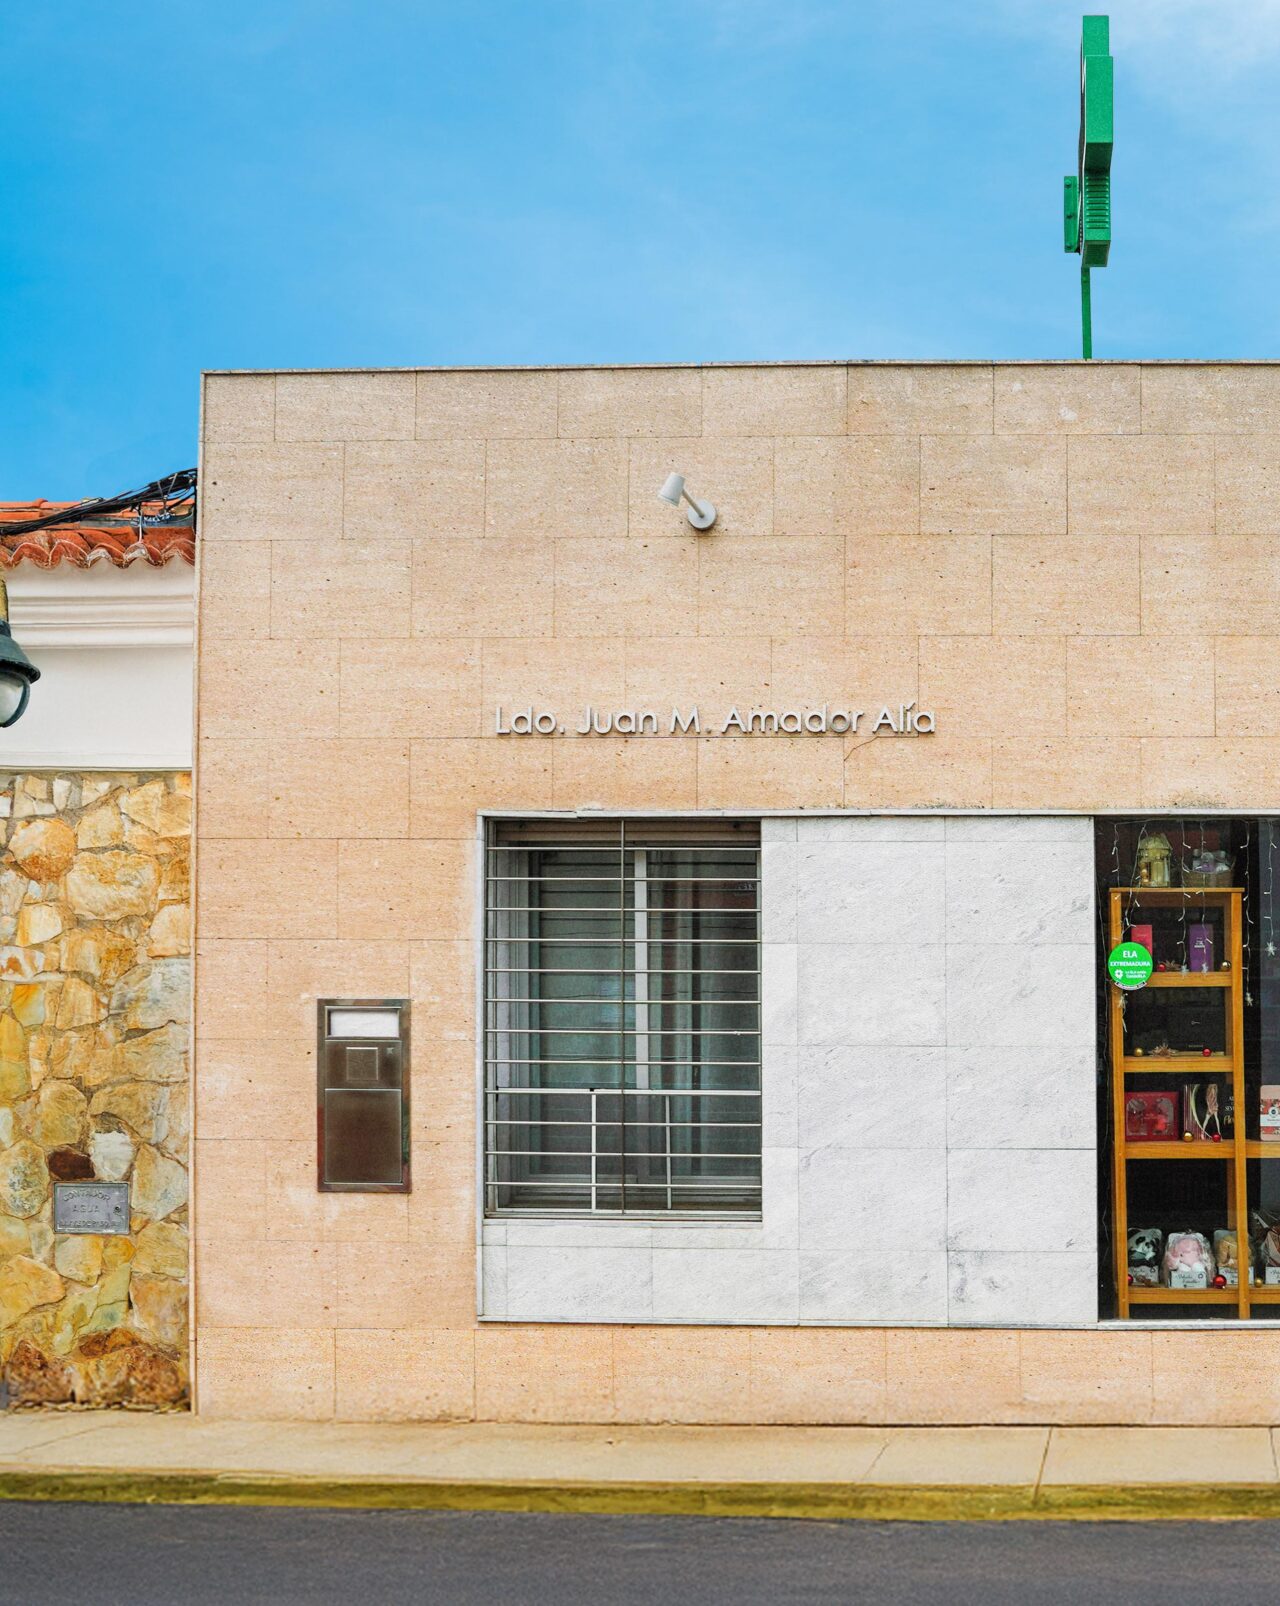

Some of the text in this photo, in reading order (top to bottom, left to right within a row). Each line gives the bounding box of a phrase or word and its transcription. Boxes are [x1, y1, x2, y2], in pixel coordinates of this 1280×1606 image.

[495, 702, 936, 735] Ldo. Juan M. Amador Alía
[1122, 950, 1138, 958] ELA
[63, 1190, 112, 1202] CONTADOR
[72, 1204, 100, 1213] AGUA
